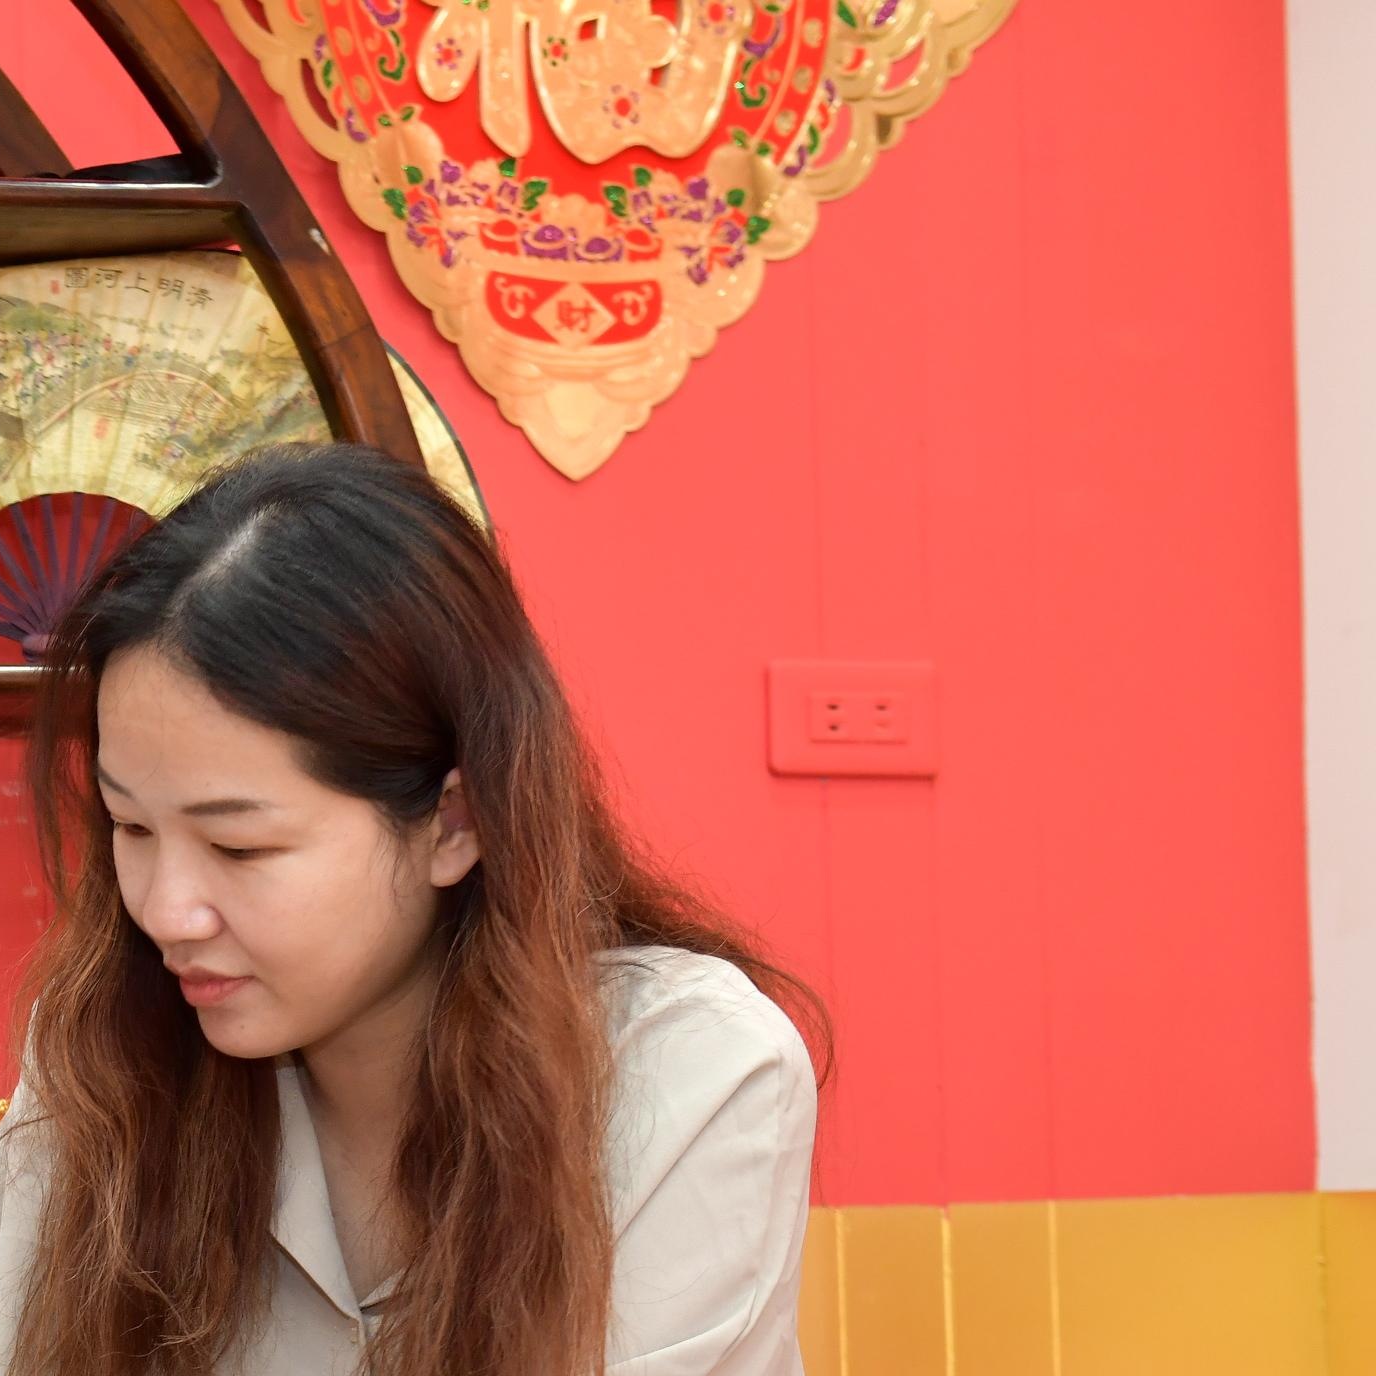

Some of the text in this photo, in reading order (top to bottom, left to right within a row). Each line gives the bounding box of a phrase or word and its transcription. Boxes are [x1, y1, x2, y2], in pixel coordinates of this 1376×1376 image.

[63, 265, 216, 310] 清明上河圖
[554, 299, 597, 333] 財
